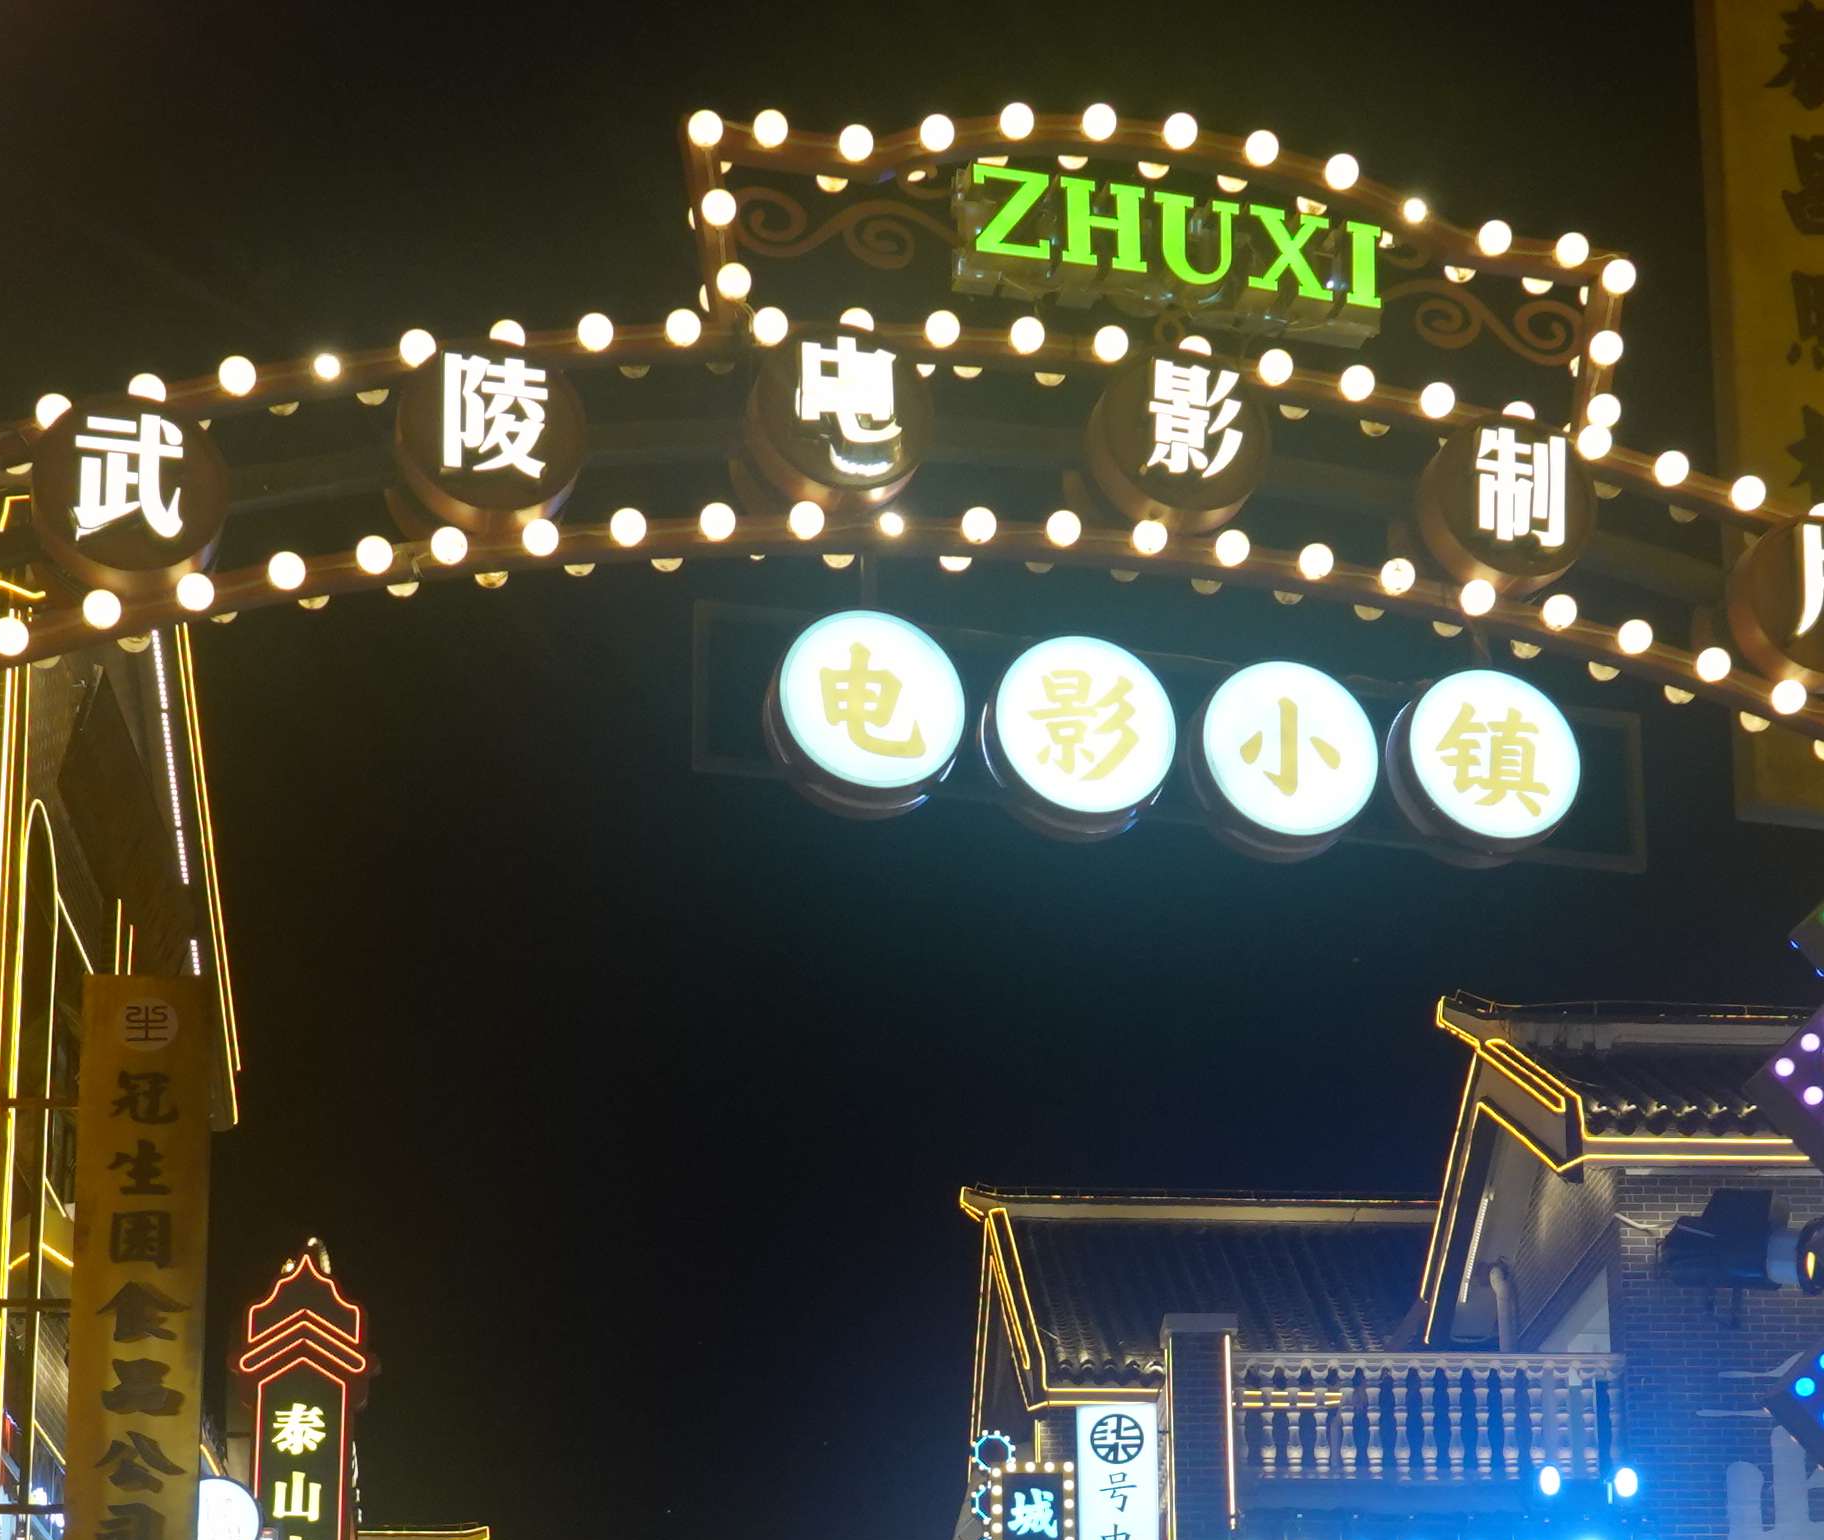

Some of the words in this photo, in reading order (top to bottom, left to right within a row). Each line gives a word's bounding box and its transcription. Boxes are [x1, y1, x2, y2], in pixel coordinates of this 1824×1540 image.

[971, 162, 1384, 310] ZHUXI
[819, 641, 1555, 817] 电影小镇
